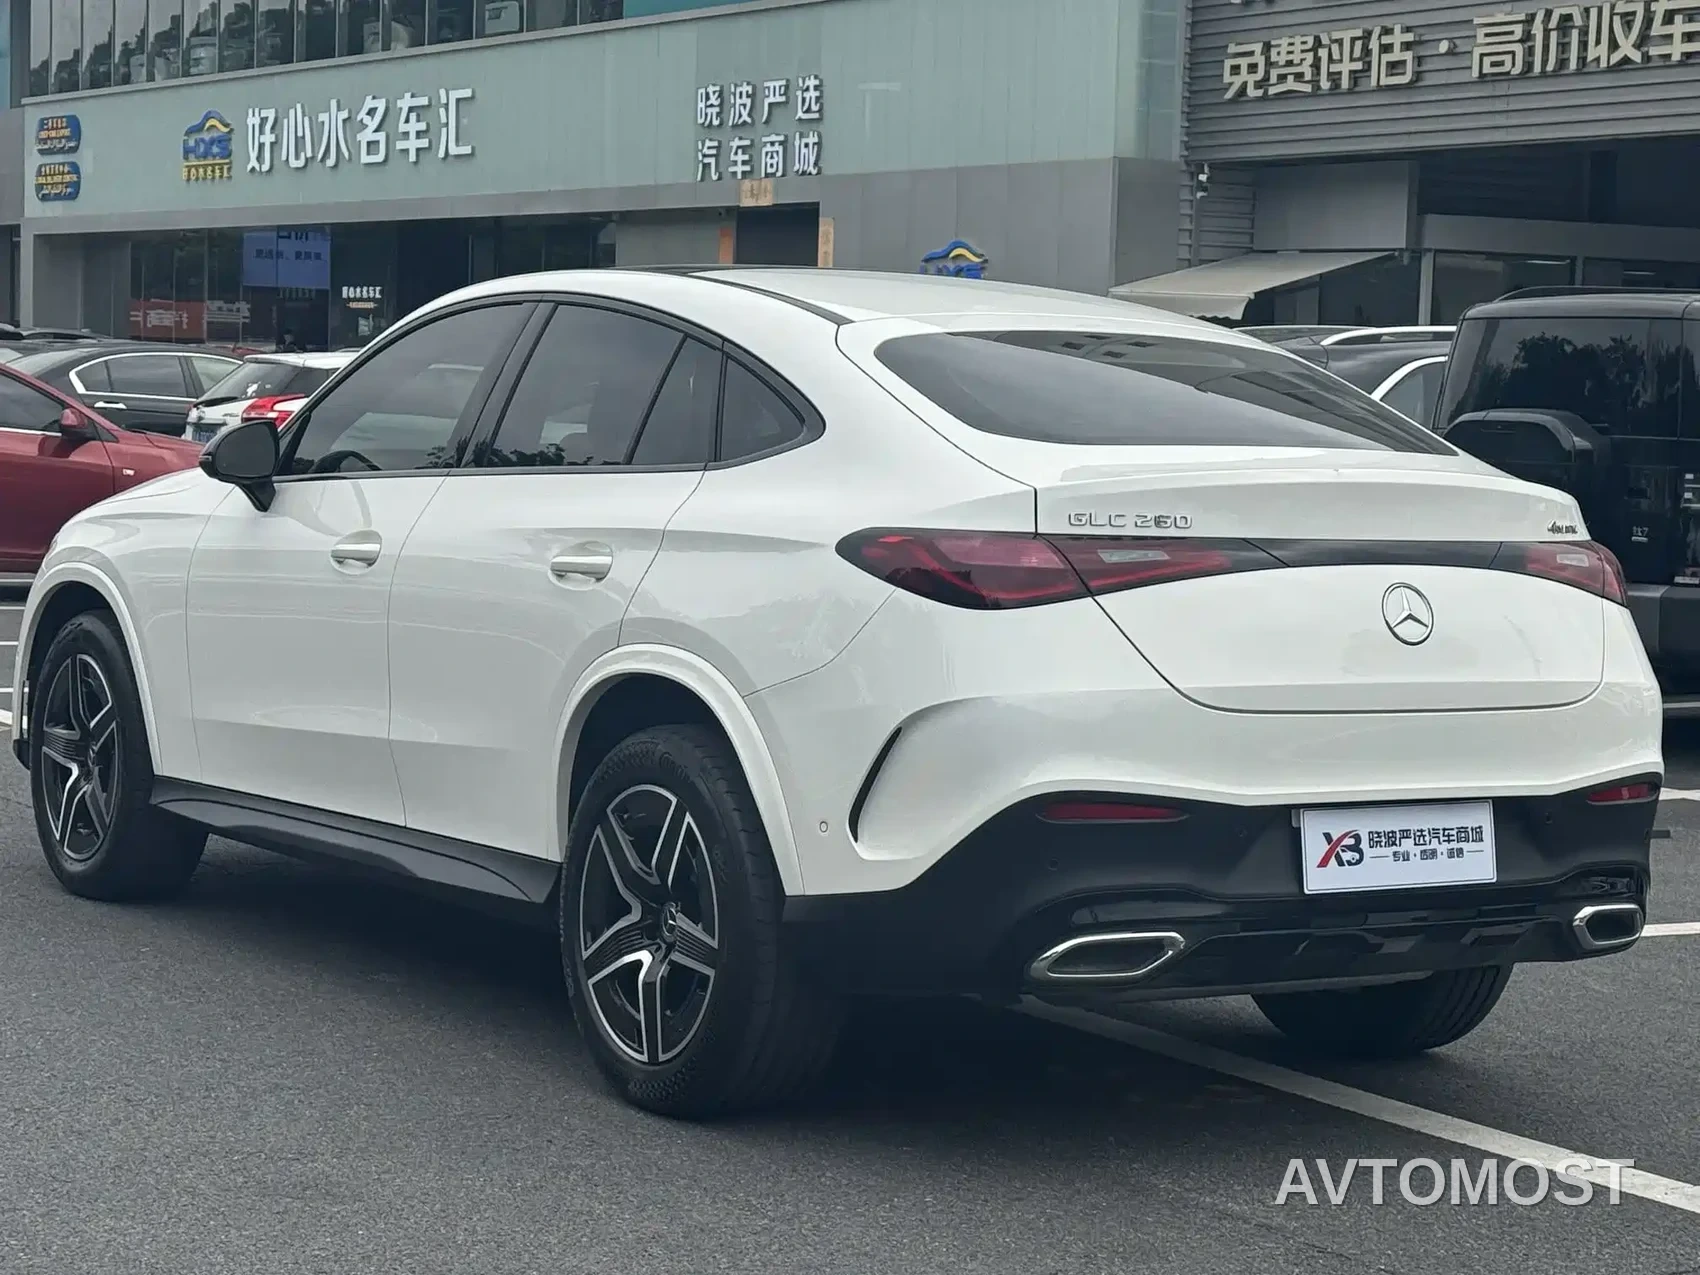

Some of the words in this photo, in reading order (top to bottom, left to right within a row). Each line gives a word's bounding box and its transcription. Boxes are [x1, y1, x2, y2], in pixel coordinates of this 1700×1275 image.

[696, 75, 821, 127] 晓波严选
[247, 88, 474, 173] 好心水名车汇
[696, 131, 820, 181] 汽车商城
[1068, 511, 1127, 528] GLC
[1134, 513, 1193, 529] 260
[1368, 825, 1485, 848] 晓波严选汽车商城
